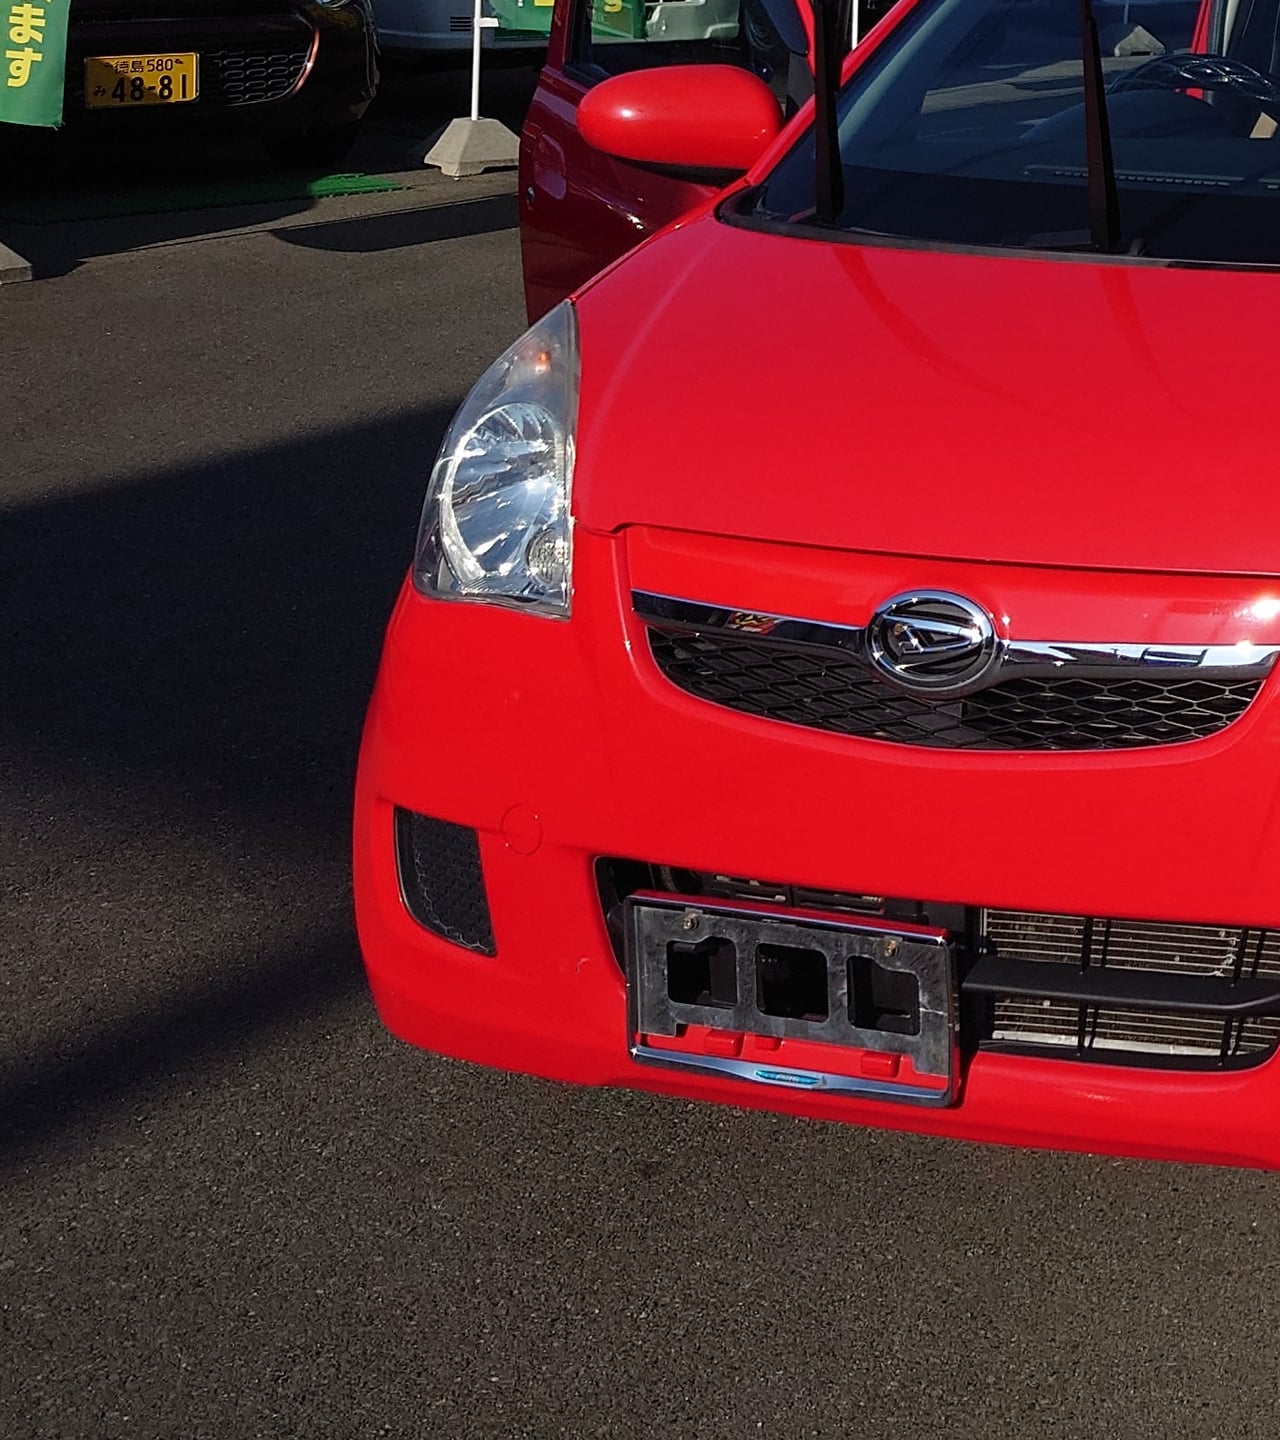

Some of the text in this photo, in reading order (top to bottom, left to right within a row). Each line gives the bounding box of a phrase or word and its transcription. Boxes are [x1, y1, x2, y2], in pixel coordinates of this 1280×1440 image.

[147, 59, 173, 72] 580
[93, 74, 187, 101] み 48-81
